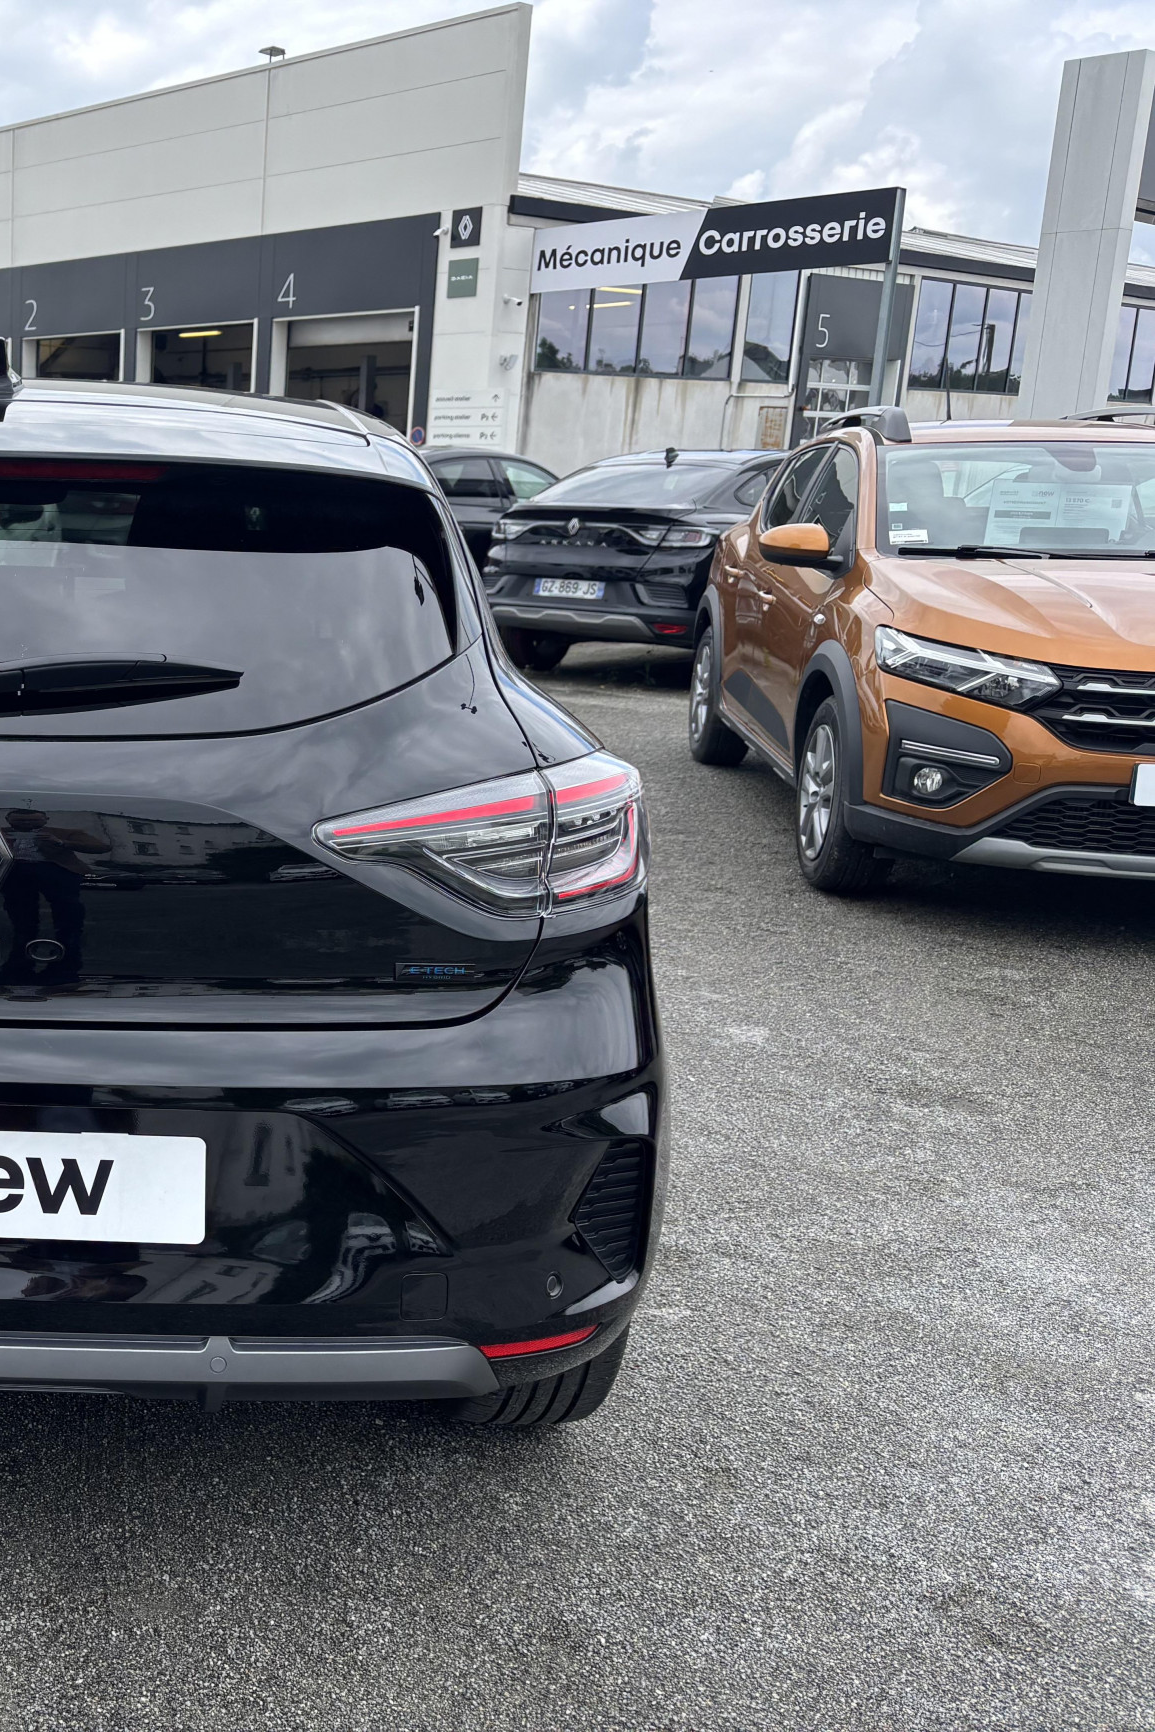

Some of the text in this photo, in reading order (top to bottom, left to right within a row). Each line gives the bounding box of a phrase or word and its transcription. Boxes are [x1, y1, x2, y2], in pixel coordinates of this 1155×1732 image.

[537, 212, 886, 272] Mécanique Carrosserie
[140, 287, 155, 321] 3
[276, 272, 297, 309] 4
[24, 300, 37, 331] 2
[816, 313, 831, 348] 5
[409, 966, 465, 975] E-TECH
